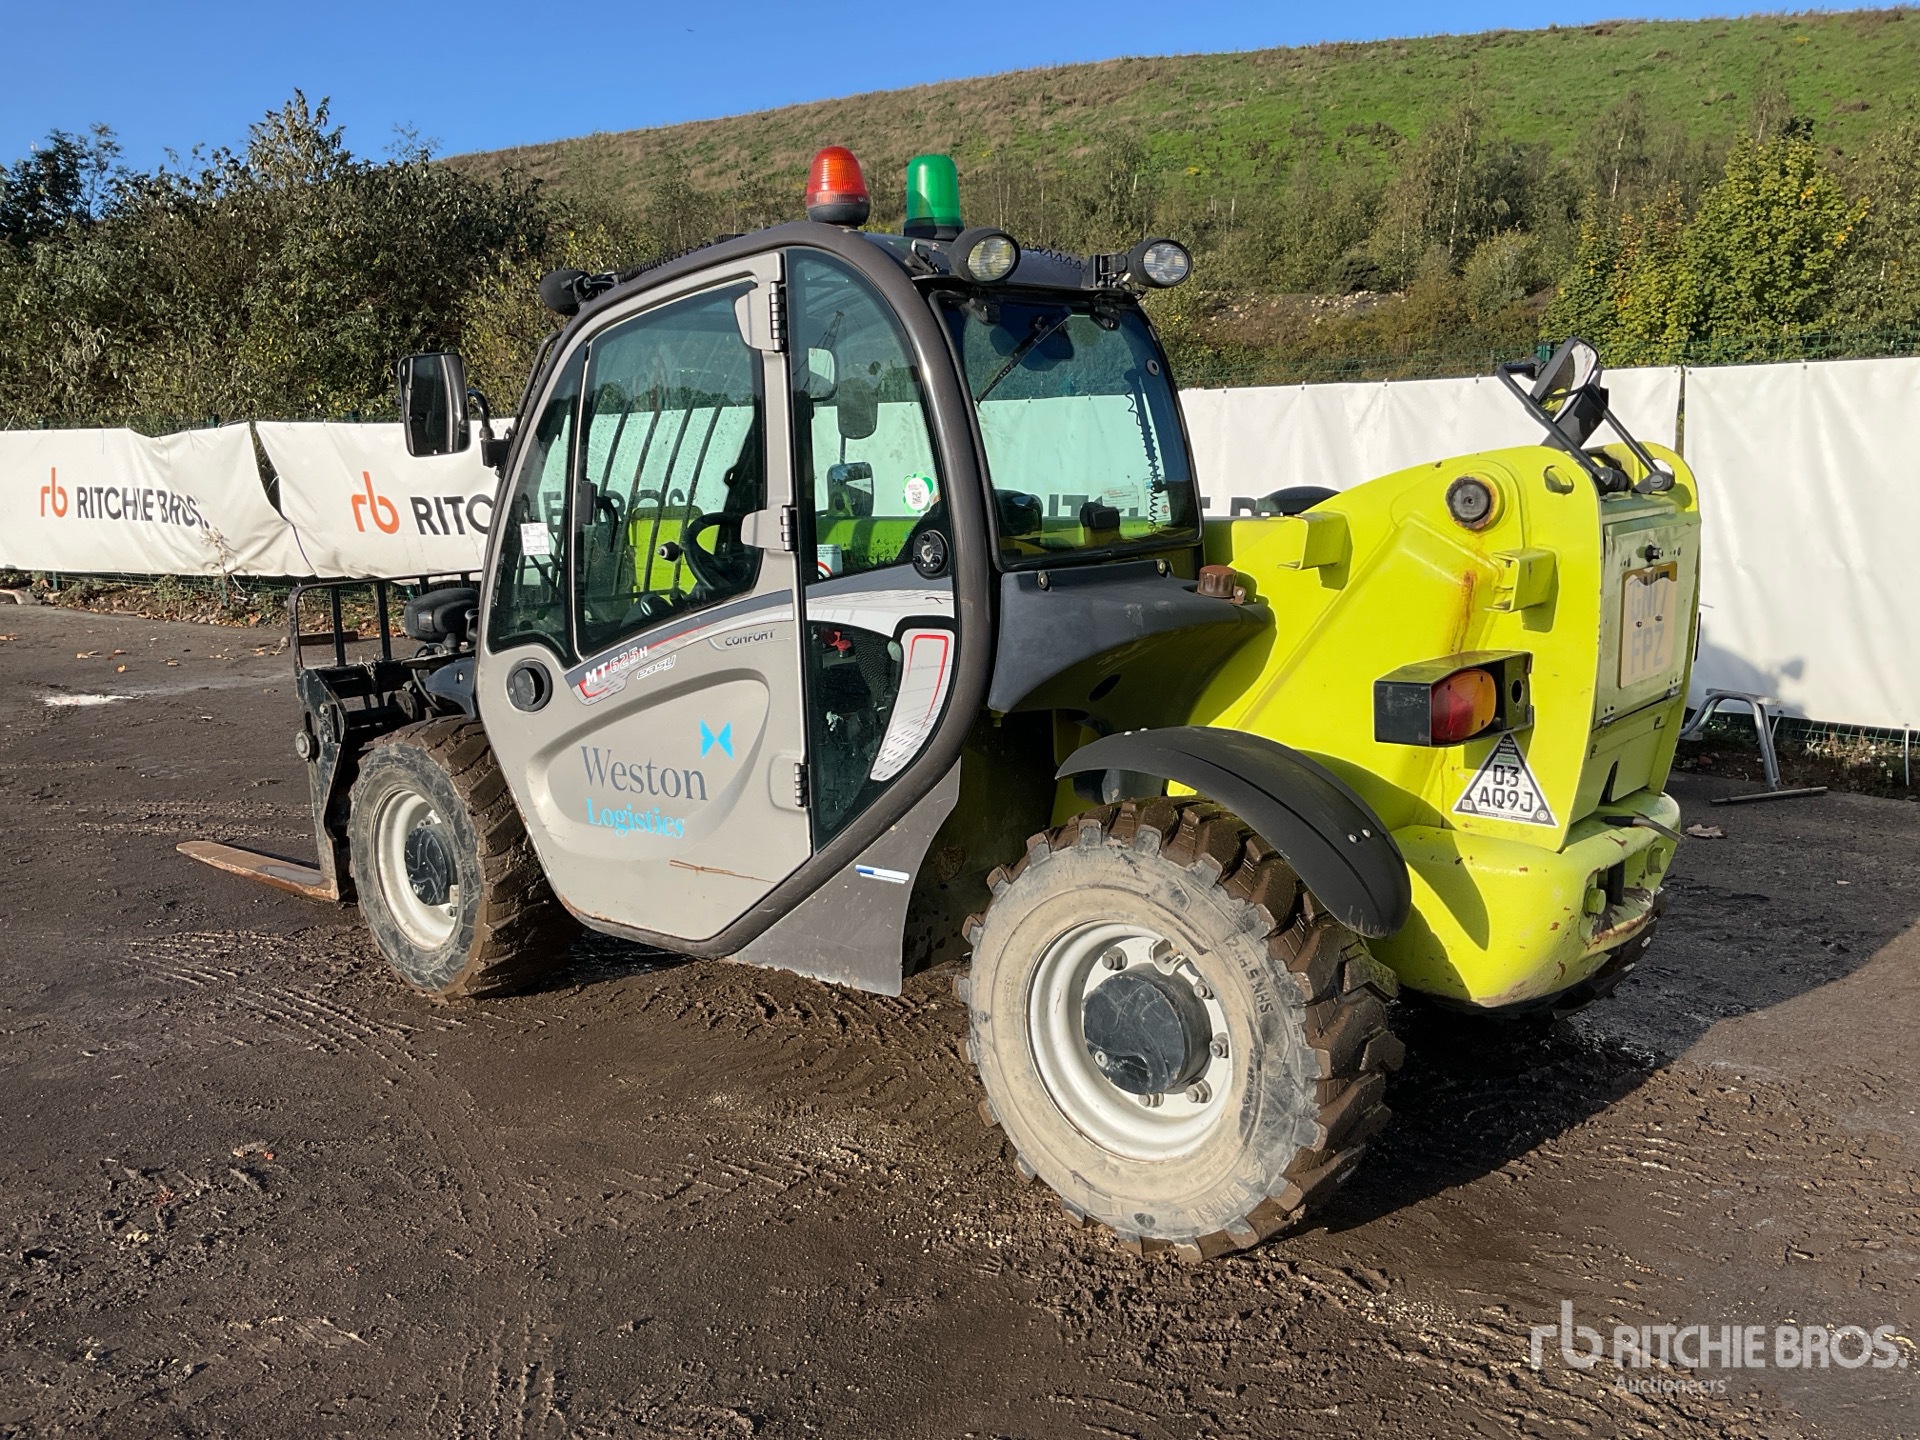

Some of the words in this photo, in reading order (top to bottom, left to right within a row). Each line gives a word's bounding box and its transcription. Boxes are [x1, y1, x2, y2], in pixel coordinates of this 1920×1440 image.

[41, 467, 68, 518] rb
[76, 486, 154, 522] RITCHIE
[351, 471, 400, 535] rb
[636, 654, 677, 680] easy
[580, 745, 709, 801] Weston
[586, 797, 686, 839] Logistics
[1477, 786, 1534, 813] AQ9J
